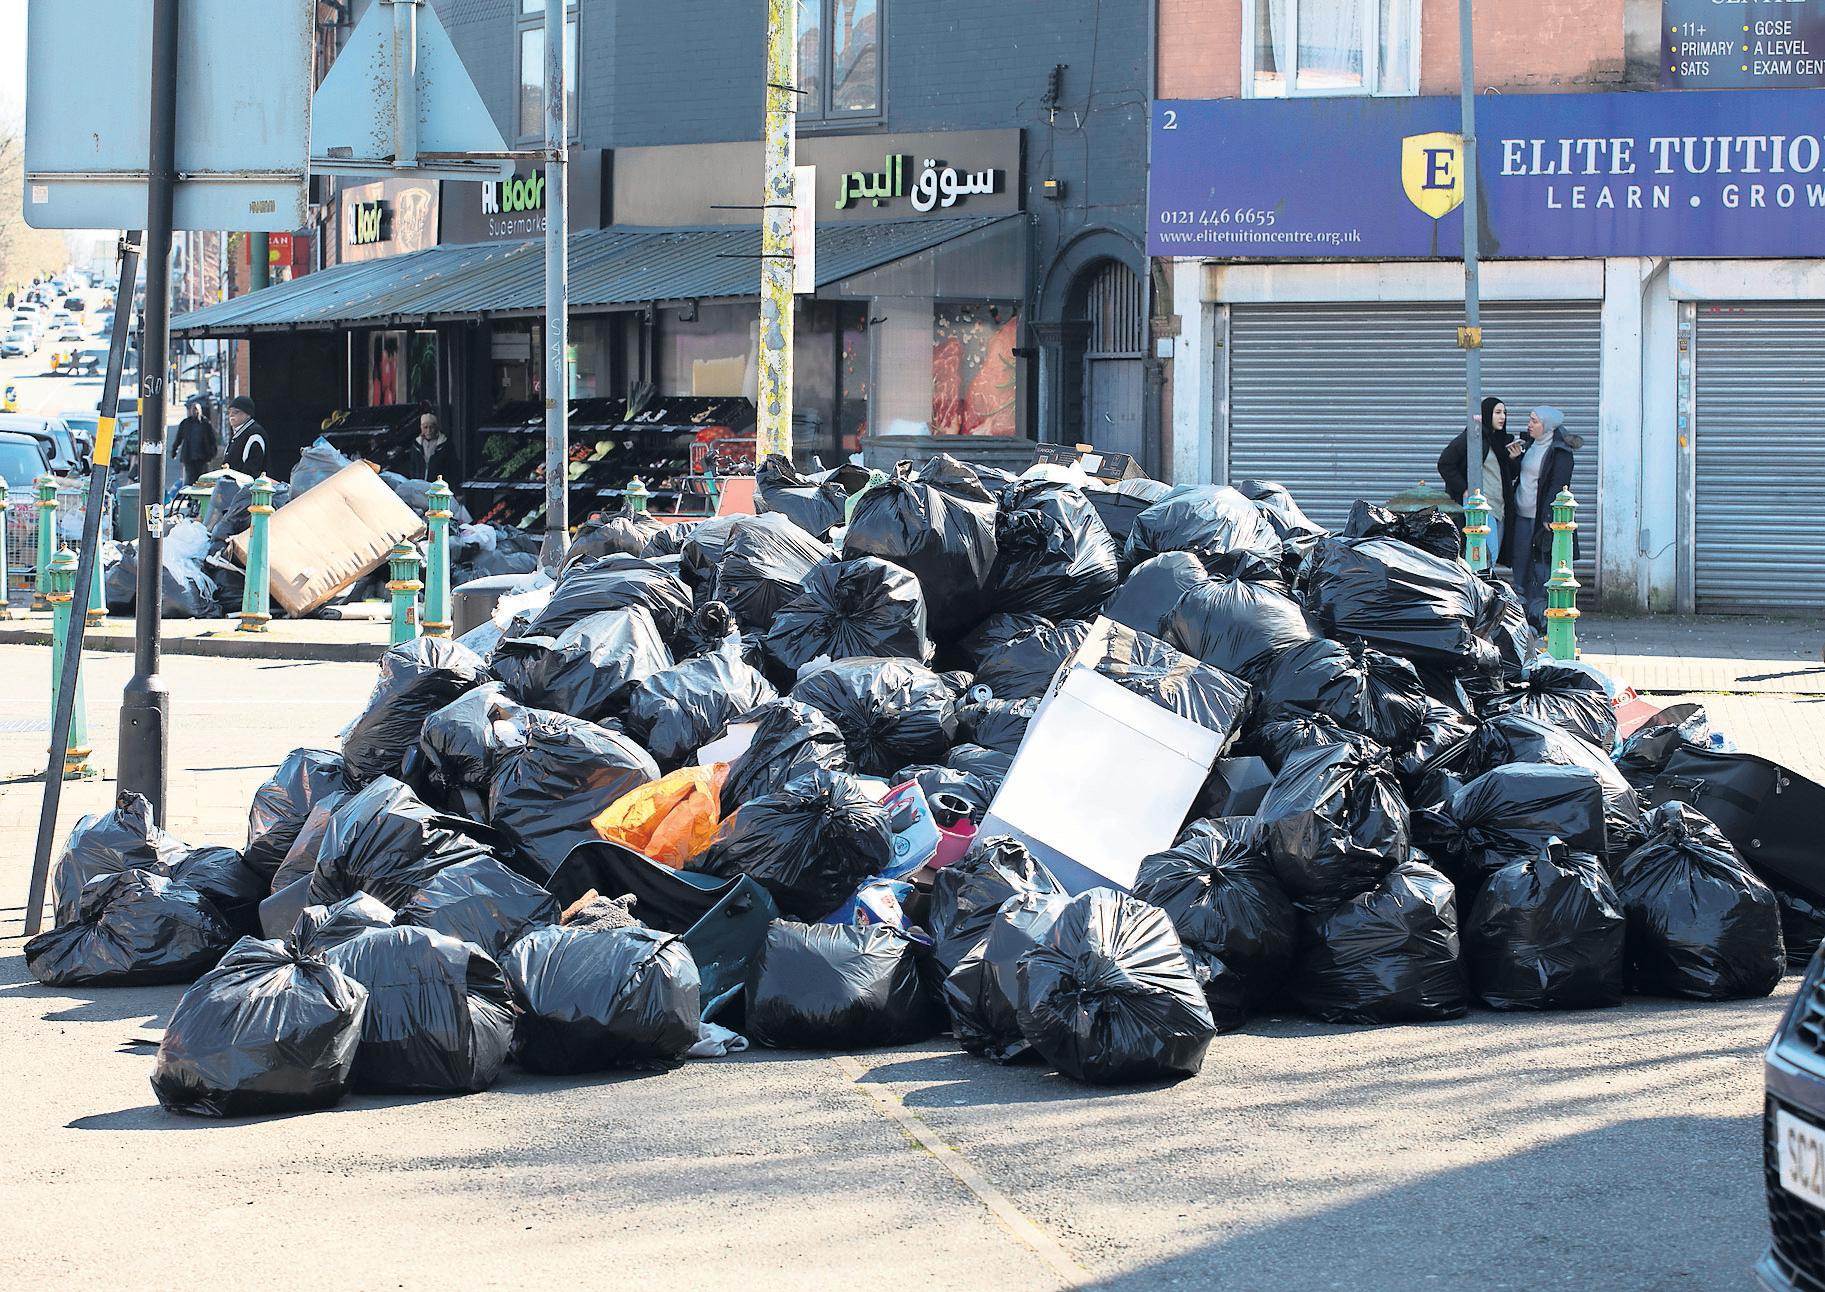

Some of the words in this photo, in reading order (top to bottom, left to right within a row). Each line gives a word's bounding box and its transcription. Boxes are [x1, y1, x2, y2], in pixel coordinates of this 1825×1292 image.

[1682, 22, 1707, 37] 11+
[1754, 20, 1792, 36] GCSE
[1681, 41, 1734, 56] PRIMARY
[1753, 41, 1764, 56] A
[1767, 40, 1809, 55] LEVEL
[1680, 61, 1710, 76] SATS
[1753, 60, 1792, 75] EXAM
[1796, 60, 1825, 75] CEN
[1162, 110, 1178, 130] 2
[1500, 137, 1636, 176] ELITE
[1648, 134, 1825, 174] TUITIO
[1421, 148, 1456, 190] E
[502, 168, 545, 213] Badr
[834, 153, 903, 210] البدر
[910, 158, 994, 212] سوق
[1547, 185, 1670, 209] LEARN
[1722, 183, 1825, 208] GROW
[489, 214, 546, 238] Supermarke
[1160, 210, 1194, 224] 0121
[1199, 208, 1230, 226] 446
[1234, 208, 1276, 226] 6655
[1159, 229, 1361, 246] www.elitetuitioncentre.org.uk
